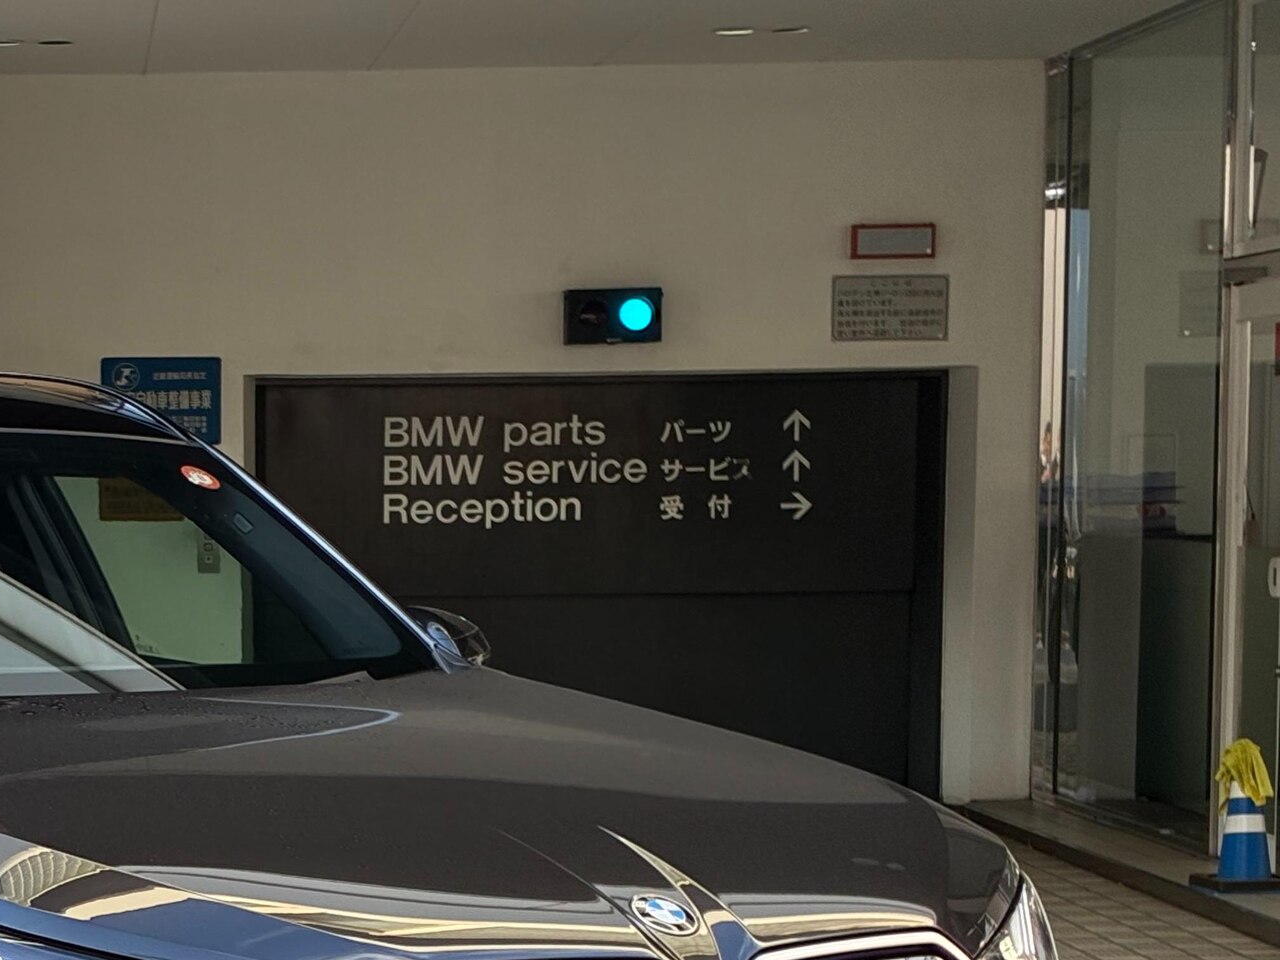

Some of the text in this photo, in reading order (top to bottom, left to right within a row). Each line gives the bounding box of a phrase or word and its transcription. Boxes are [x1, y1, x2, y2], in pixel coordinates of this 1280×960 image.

[383, 414, 606, 452] BMW parts
[659, 419, 732, 443] パーツ
[383, 451, 648, 486] BMW service
[382, 490, 582, 529] Reception
